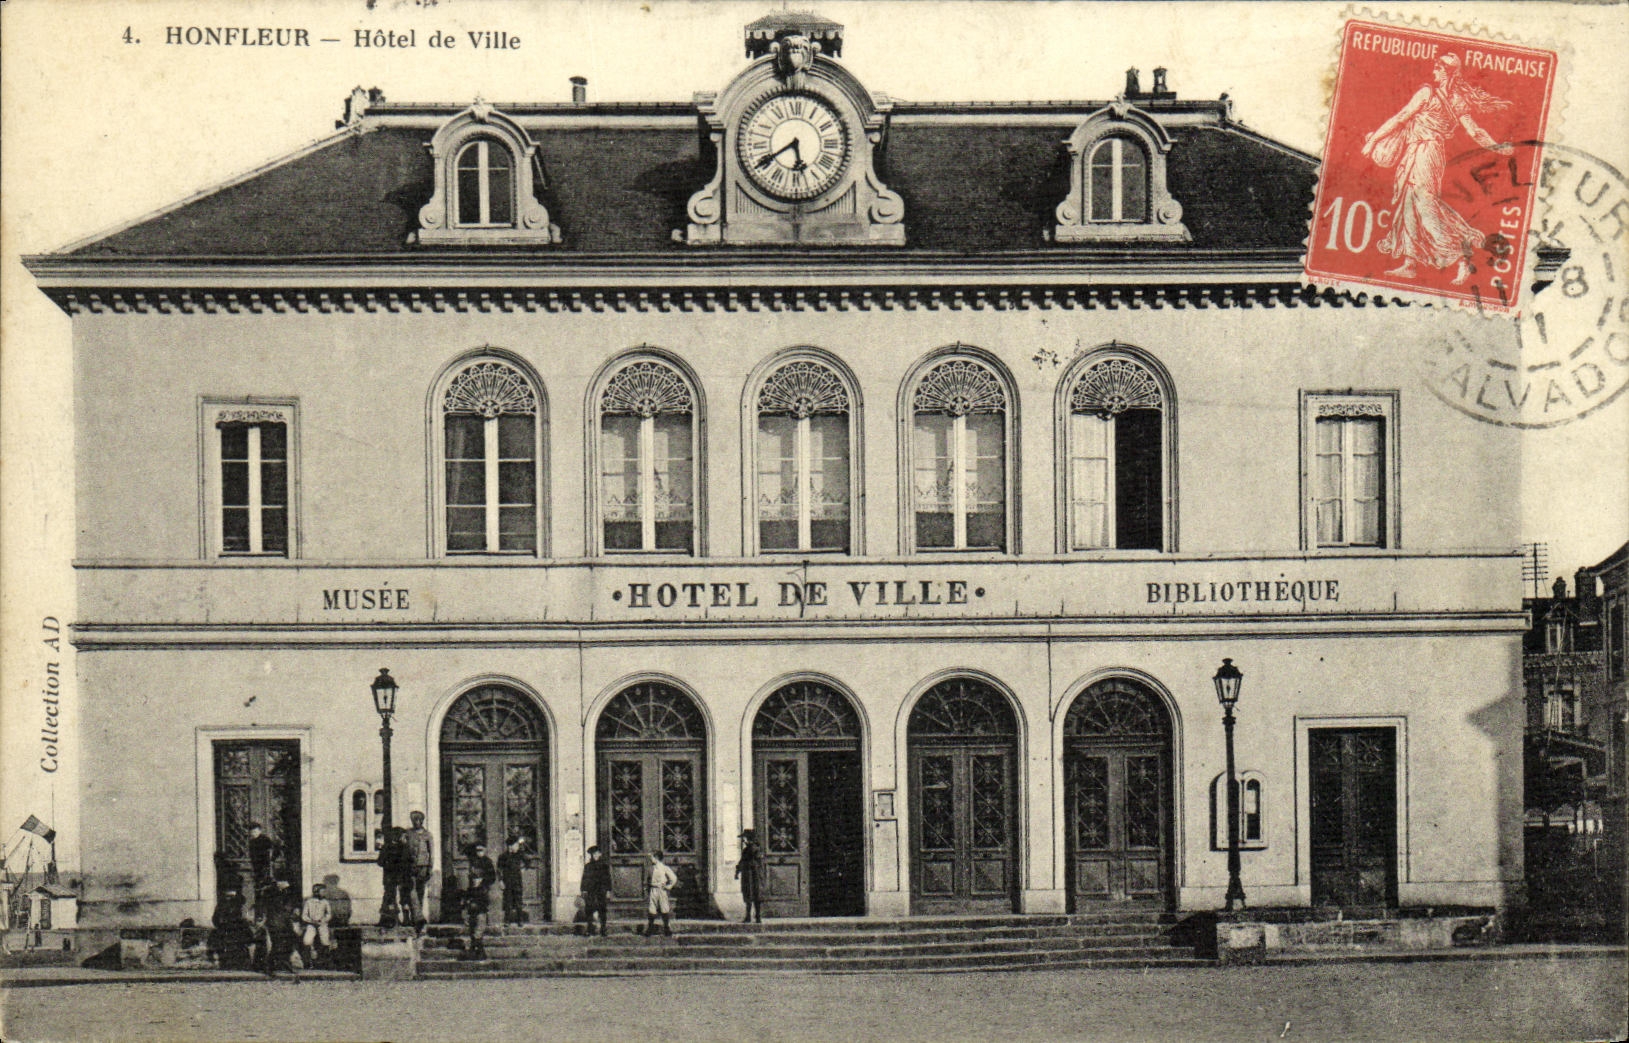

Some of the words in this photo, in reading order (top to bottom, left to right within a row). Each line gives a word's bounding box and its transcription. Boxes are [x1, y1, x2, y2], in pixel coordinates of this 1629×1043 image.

[1464, 49, 1546, 78] FRANÇAISE
[1490, 206, 1521, 288] POSTES
[323, 581, 410, 610] MUSÉE
[628, 582, 758, 608] HOTEL
[778, 581, 828, 607] DE
[847, 580, 968, 606] VILLE
